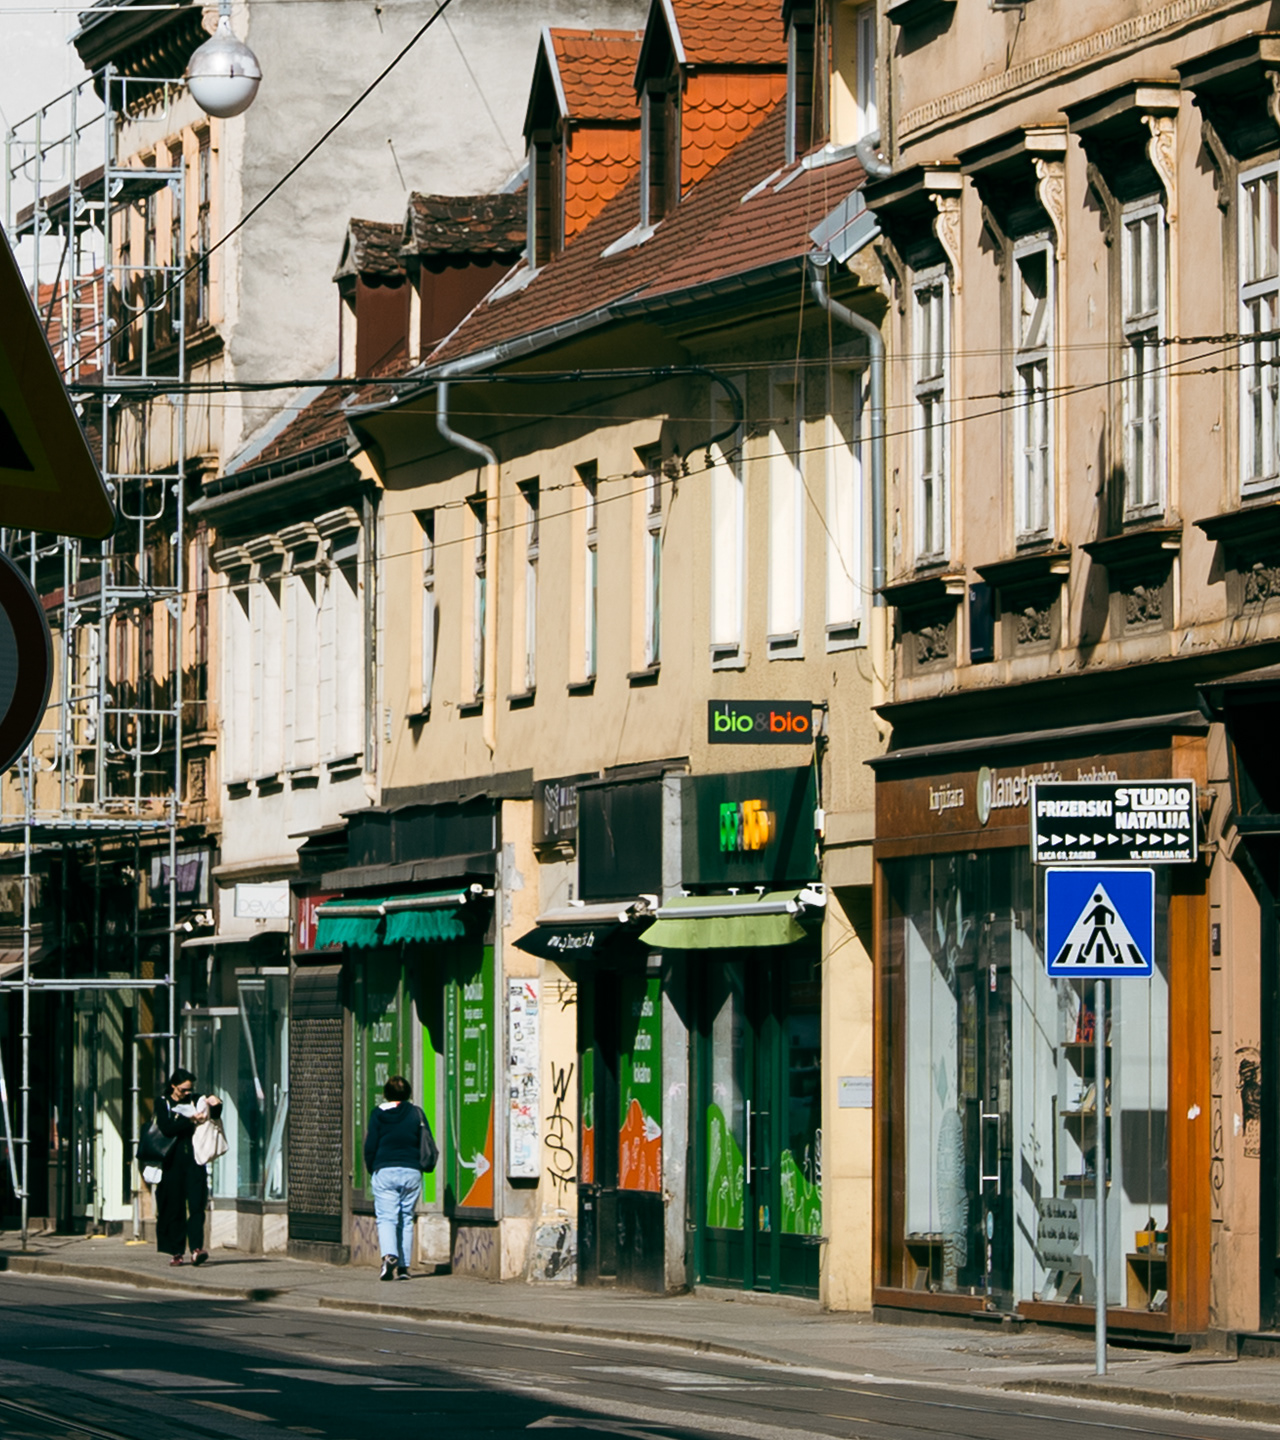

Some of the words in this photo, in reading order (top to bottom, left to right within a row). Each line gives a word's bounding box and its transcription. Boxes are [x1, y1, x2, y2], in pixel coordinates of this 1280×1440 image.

[714, 711, 809, 733] bio&bio
[1037, 800, 1113, 818] FRIZERSKI
[1115, 789, 1191, 810] STUDIO
[1115, 812, 1191, 830] NATALIJA
